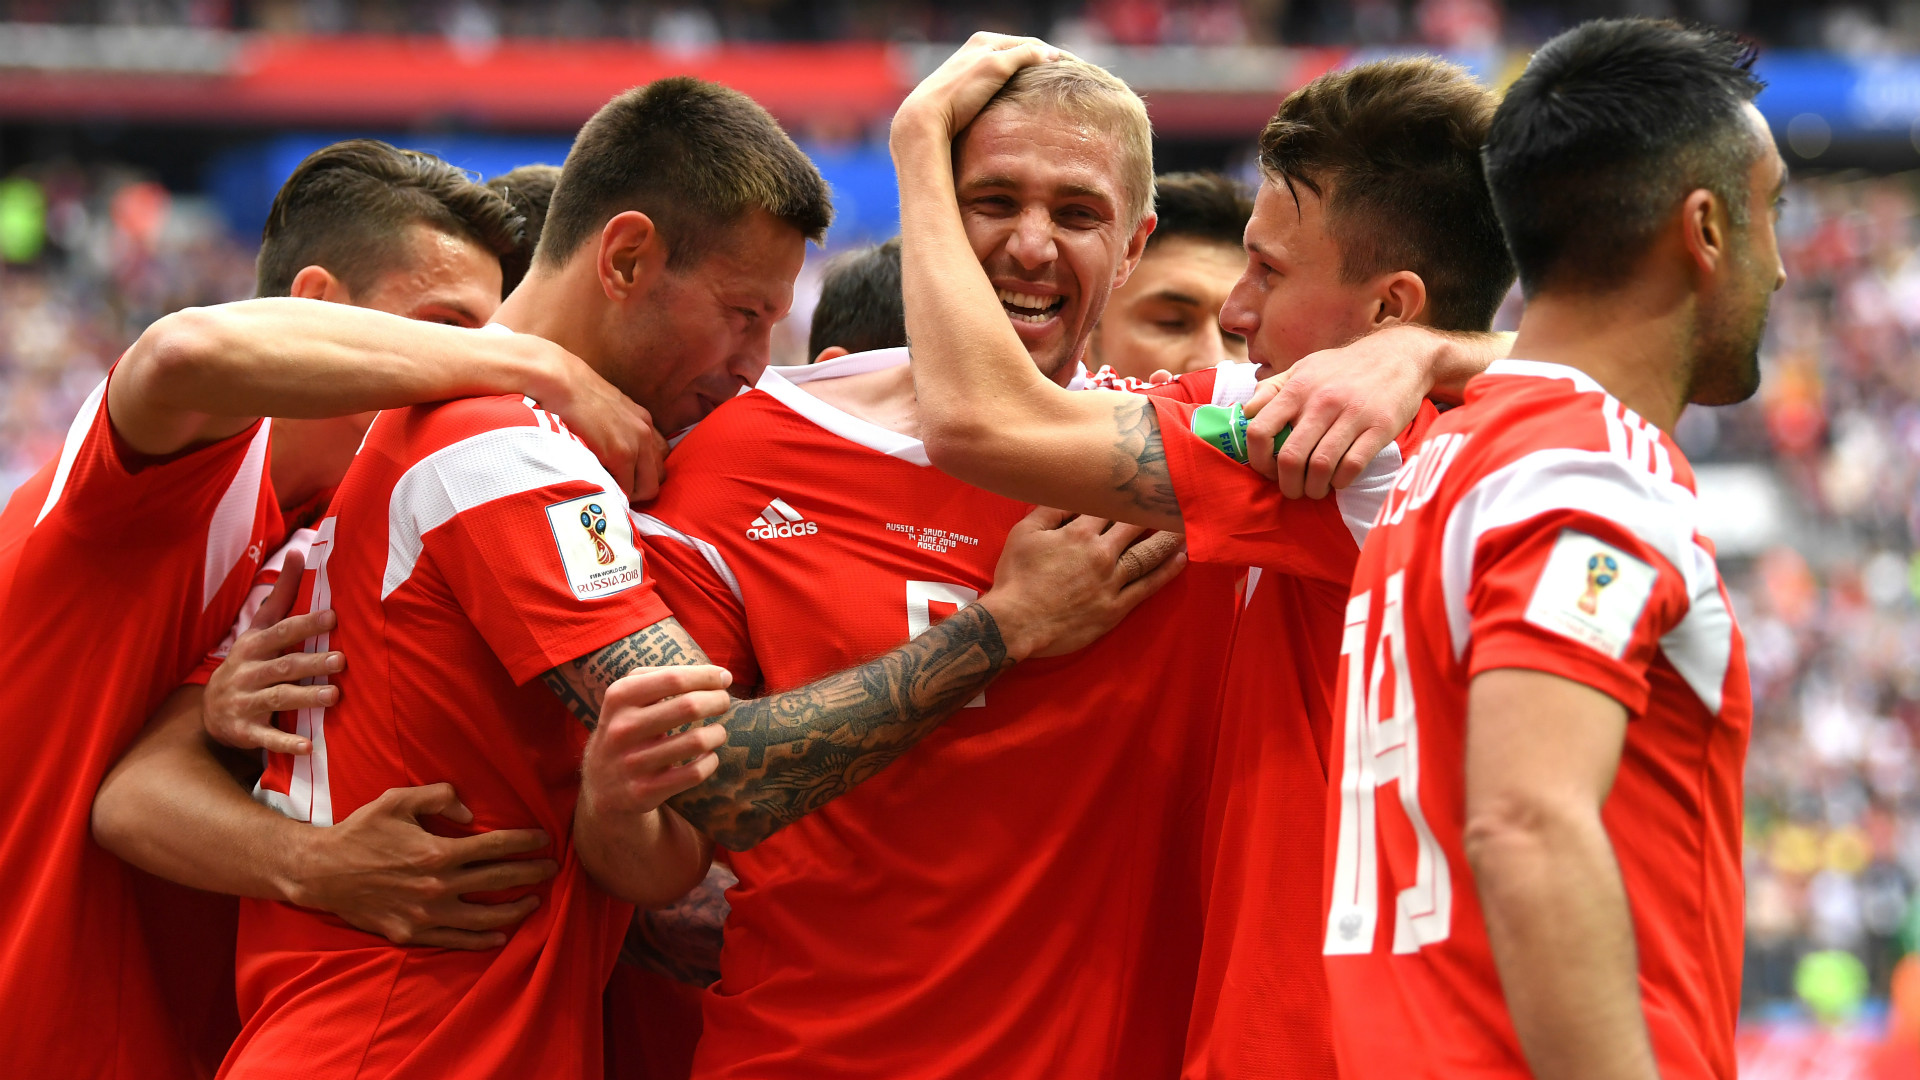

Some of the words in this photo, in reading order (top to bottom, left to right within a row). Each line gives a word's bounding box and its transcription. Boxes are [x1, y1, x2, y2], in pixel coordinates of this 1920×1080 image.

[745, 521, 818, 541] adidas
[886, 522, 914, 533] RUSSIA
[923, 528, 947, 538] SAUDI
[948, 532, 978, 546] ARABIA
[908, 533, 916, 541] 14
[918, 534, 936, 544] JUNE
[938, 538, 956, 548] 2018
[917, 542, 947, 552] MOSCOW
[577, 575, 619, 593] RUSSIA
[619, 569, 639, 584] 2018
[601, 568, 618, 576] WORLD
[1322, 570, 1452, 955] 19
